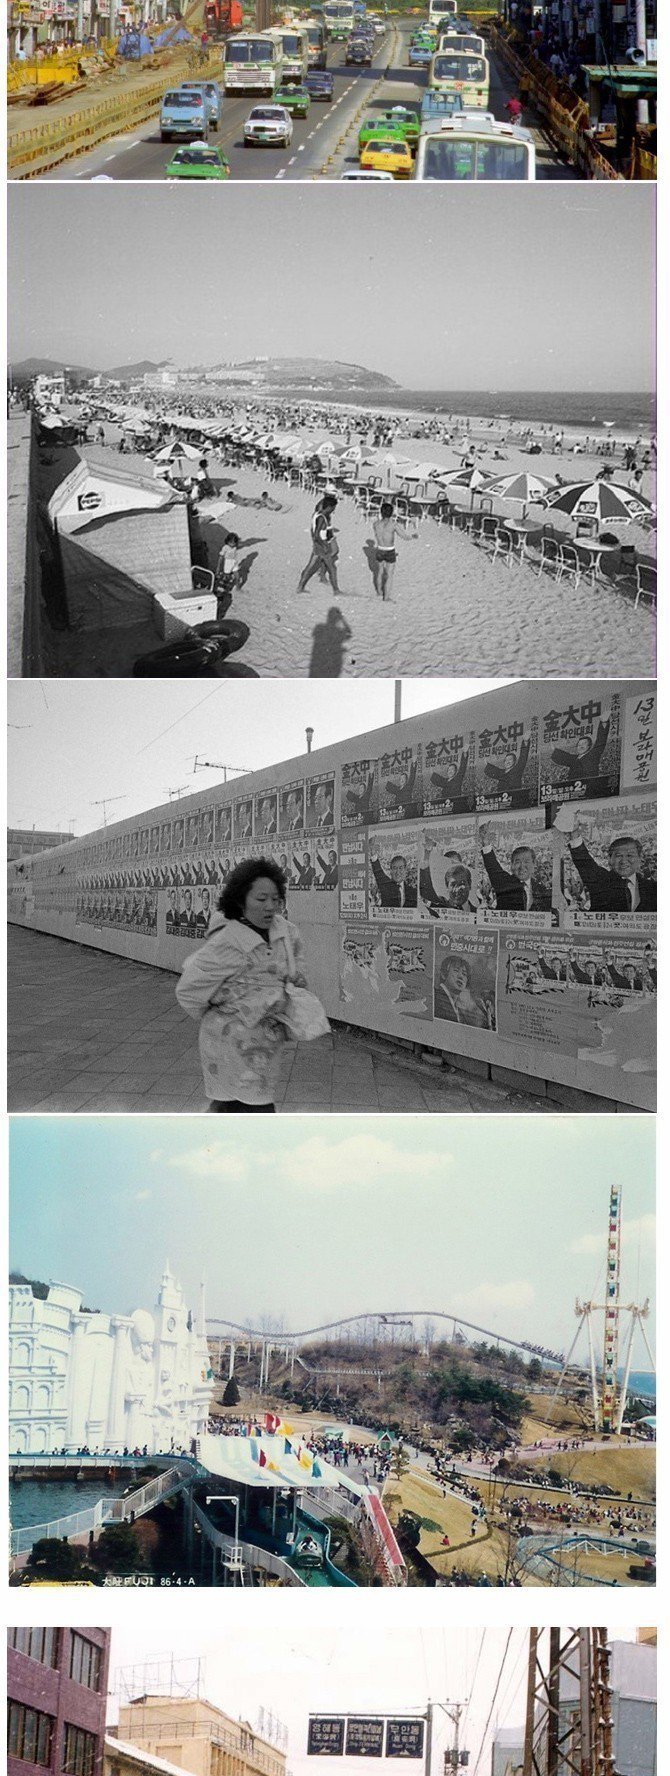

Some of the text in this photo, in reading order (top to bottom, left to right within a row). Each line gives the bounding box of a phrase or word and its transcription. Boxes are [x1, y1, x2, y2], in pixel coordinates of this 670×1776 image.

[544, 700, 602, 733] 金大中
[478, 721, 524, 749] 金大中
[544, 725, 594, 744] 당선 확인대회
[426, 735, 464, 760] 金大中
[479, 742, 518, 759] 당선 확인대회
[381, 747, 413, 771] 金大中
[342, 902, 364, 910] 노태우
[491, 910, 517, 918] 노태우
[583, 912, 619, 921] 노태우
